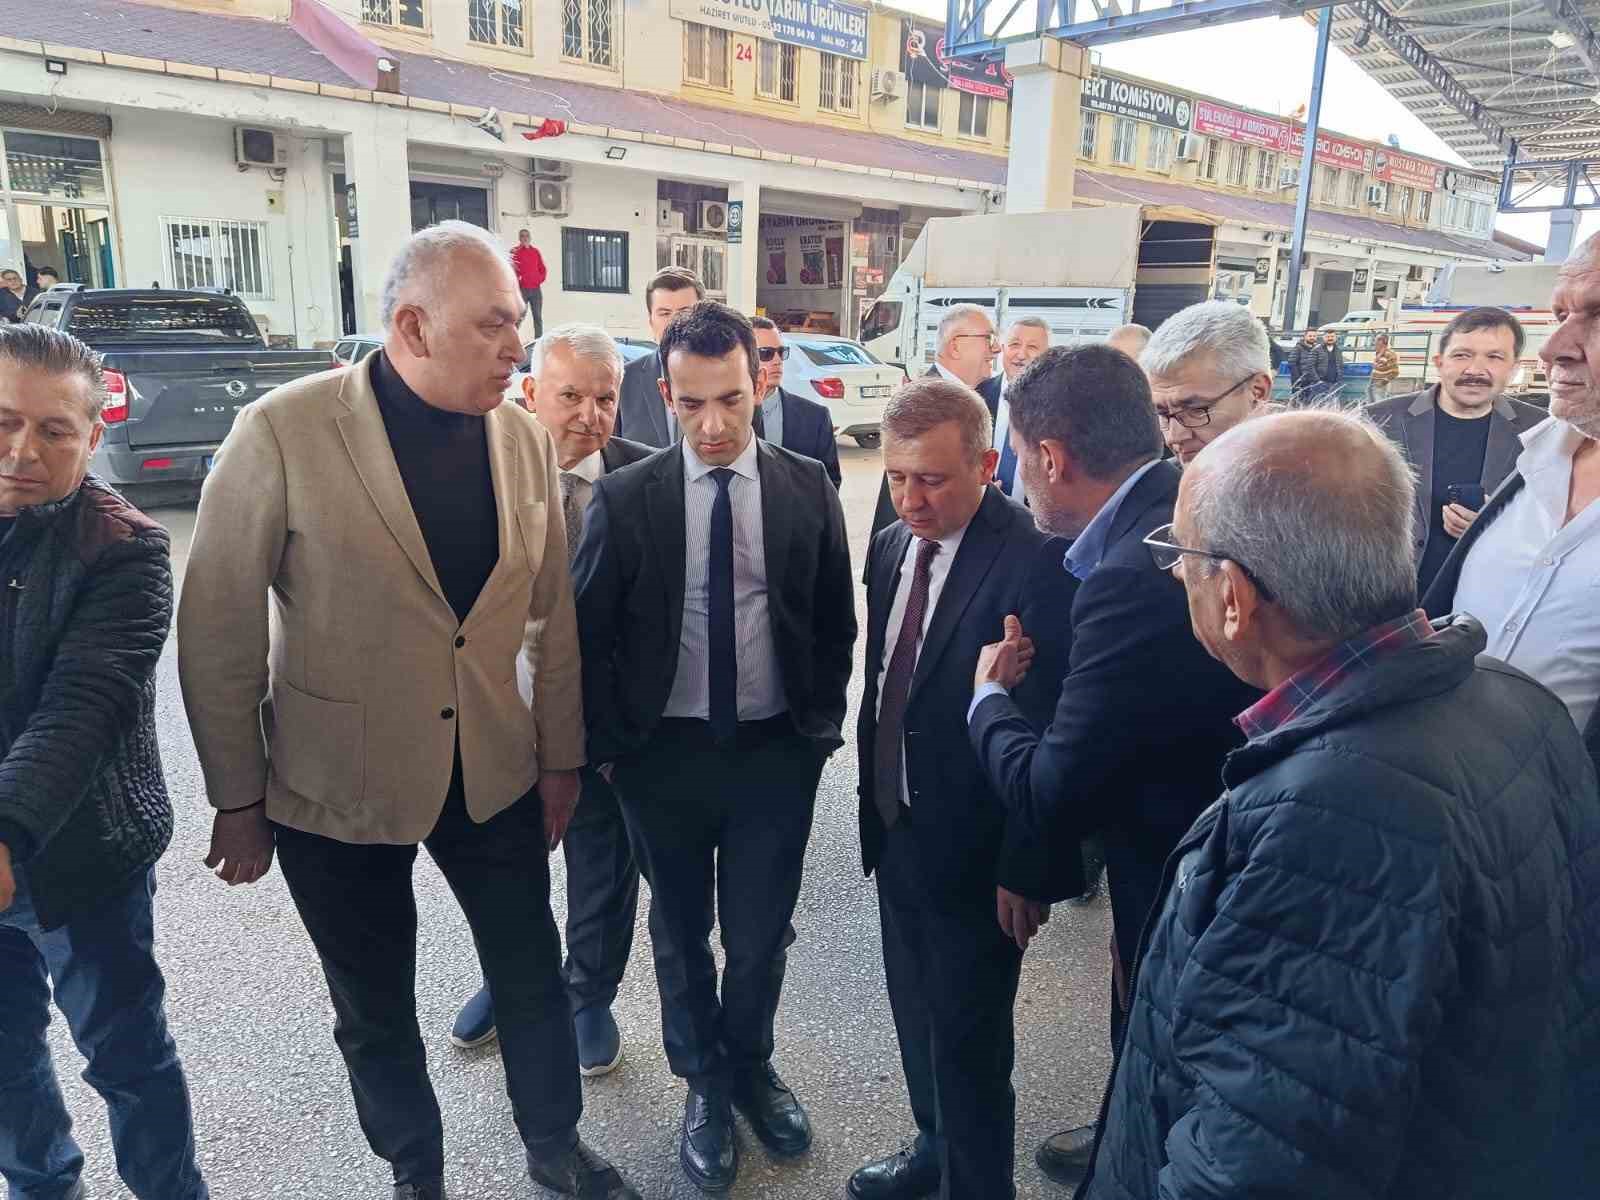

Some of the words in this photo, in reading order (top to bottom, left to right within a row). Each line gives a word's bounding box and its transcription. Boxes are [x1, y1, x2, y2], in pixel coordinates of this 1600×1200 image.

[769, 0, 808, 24] TARIM
[811, 0, 866, 37] ÜRÜNLERİ
[736, 43, 753, 61] 24
[850, 38, 864, 54] 24
[1080, 79, 1108, 98] ERT
